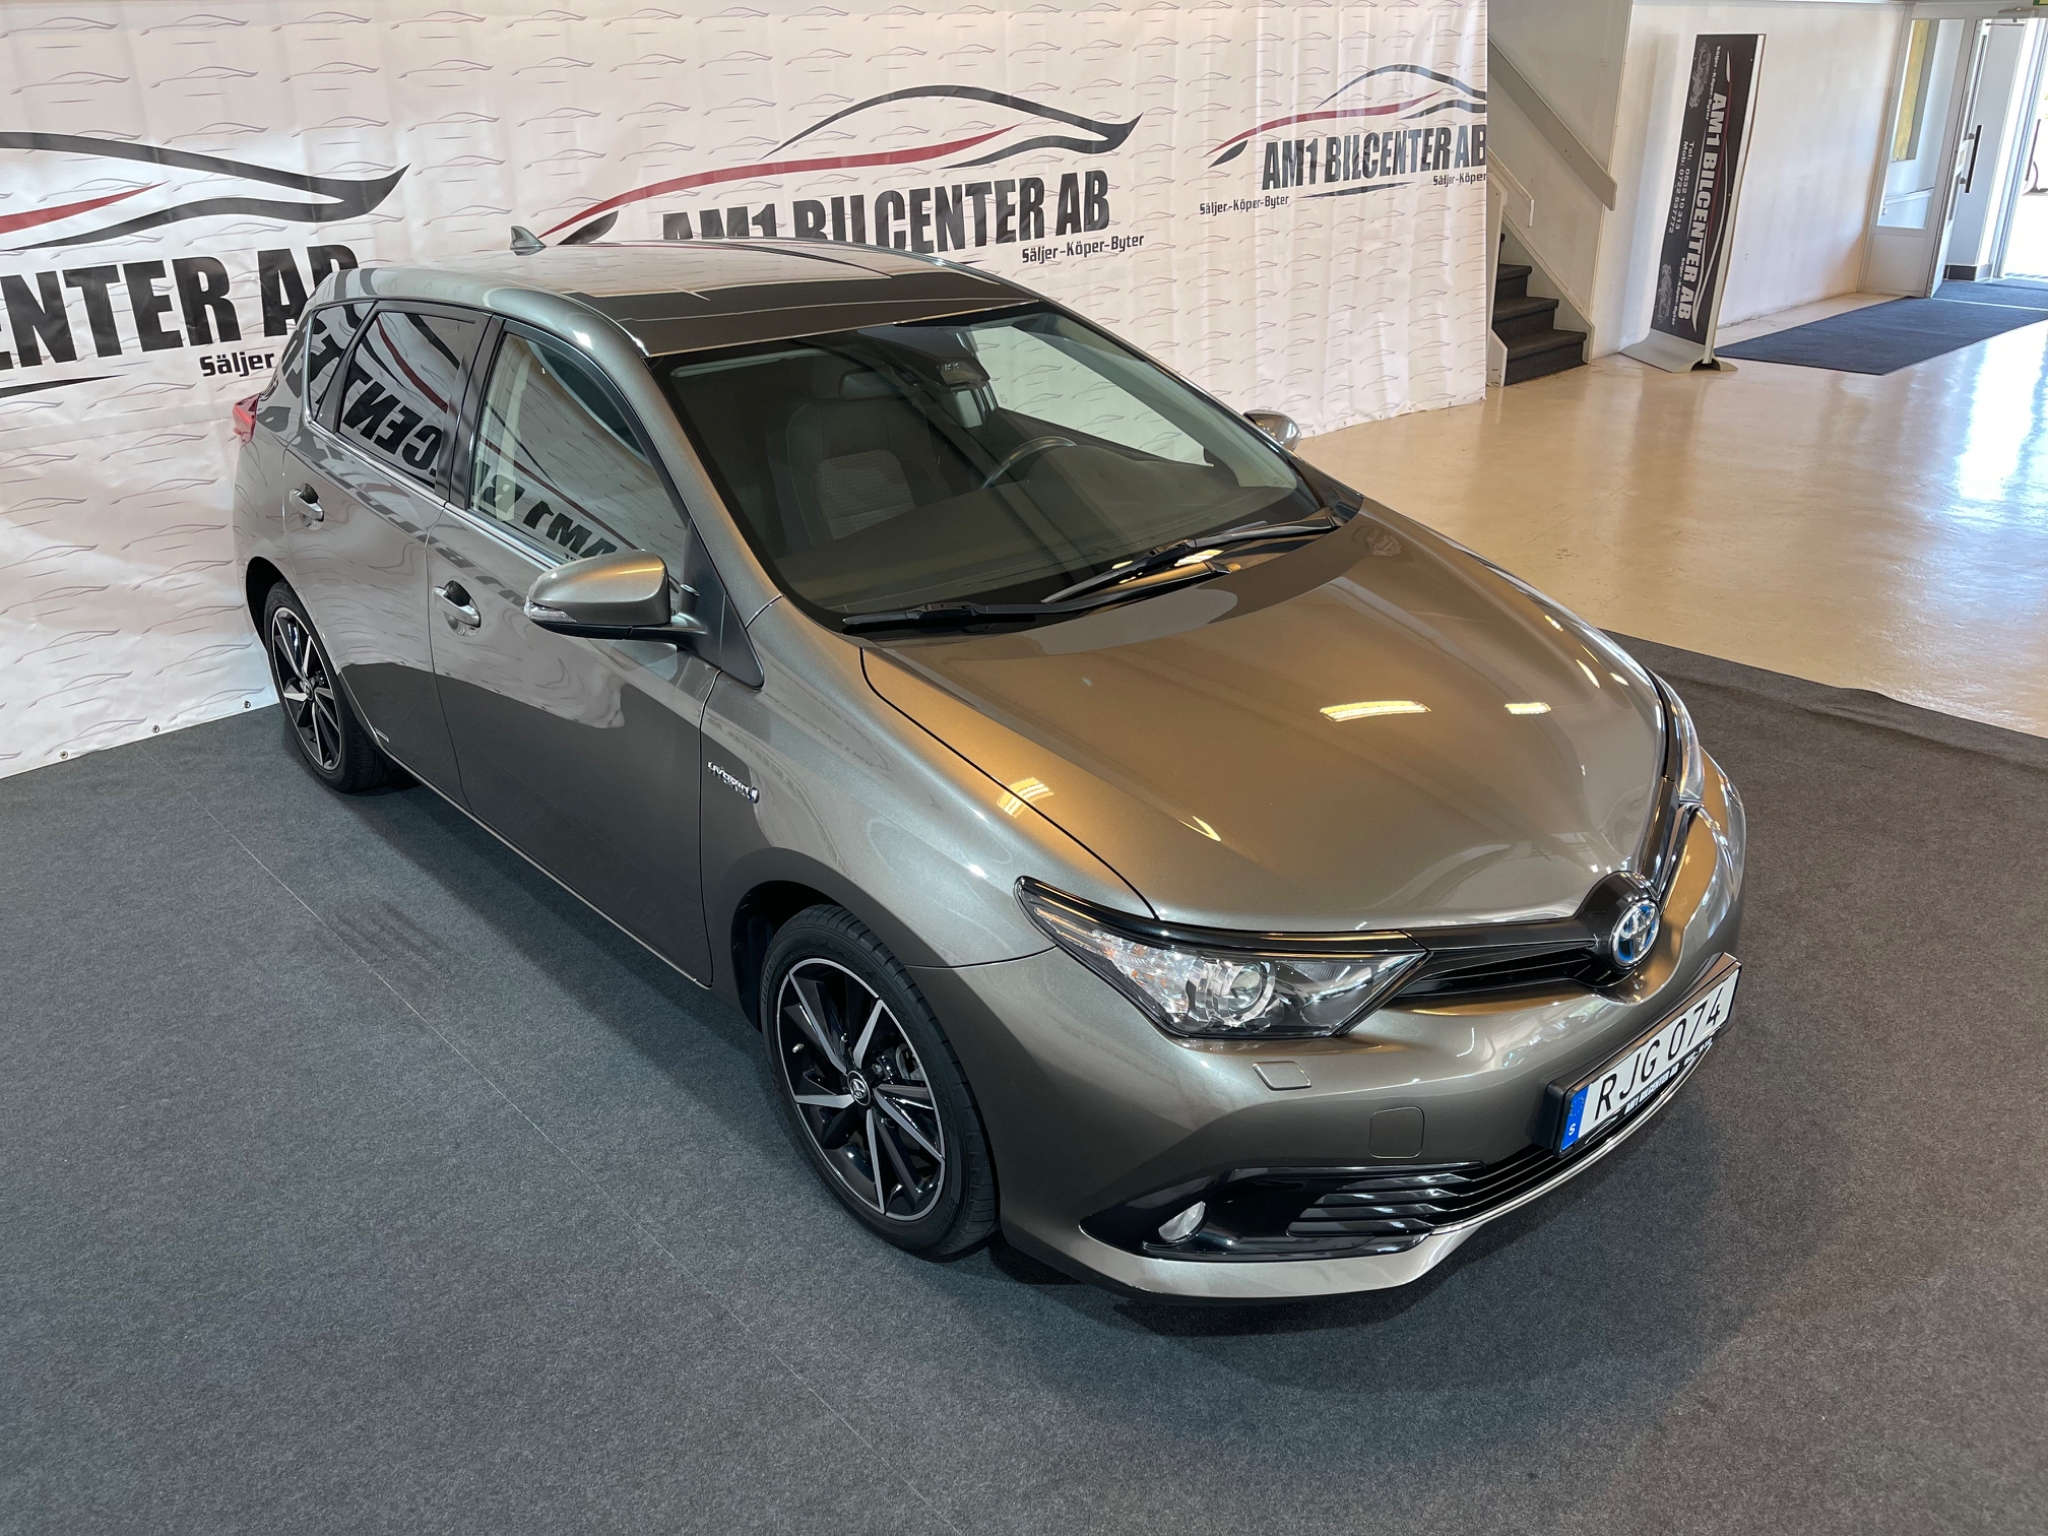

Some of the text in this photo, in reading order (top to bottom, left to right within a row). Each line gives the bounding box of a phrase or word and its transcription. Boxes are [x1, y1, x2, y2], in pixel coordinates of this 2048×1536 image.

[1262, 124, 1486, 190] AM1 BILCENTER AB
[1055, 170, 1110, 236] AB
[1678, 92, 1727, 319] AM1 BILCENTER AB
[1022, 234, 1145, 264] Säljer-Köper-Byter
[0, 256, 242, 370] NTER
[199, 352, 275, 377] Säljer
[1594, 986, 1724, 1121] RJG 074
[1568, 1123, 1576, 1136] S
